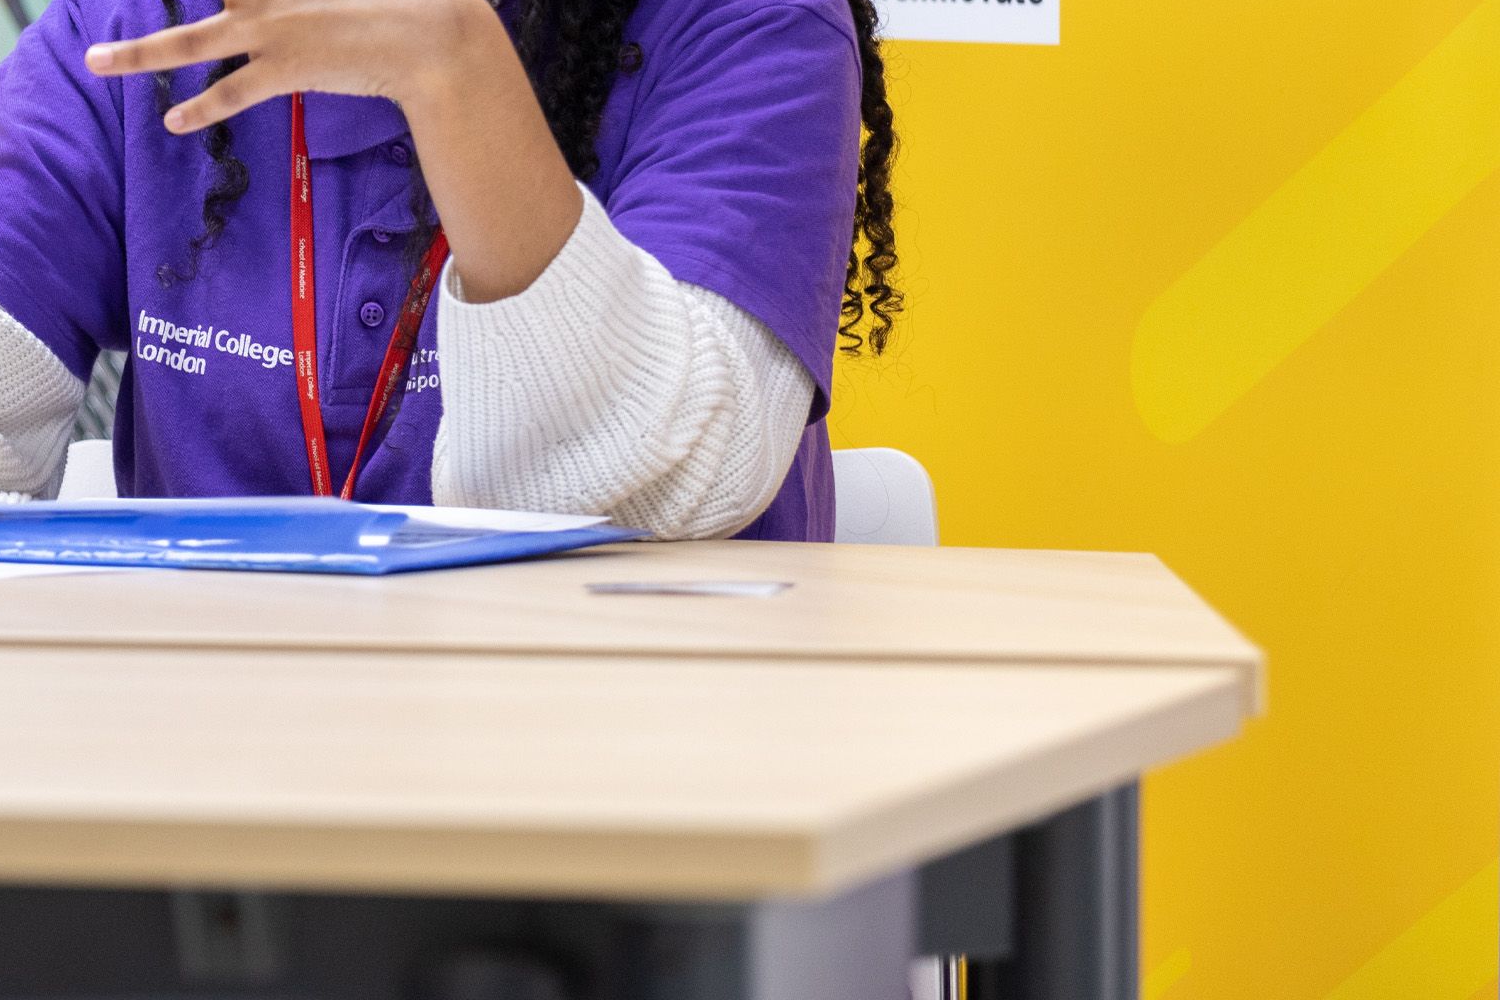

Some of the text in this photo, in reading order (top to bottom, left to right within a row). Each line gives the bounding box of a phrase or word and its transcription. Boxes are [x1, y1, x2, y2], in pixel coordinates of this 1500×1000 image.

[136, 336, 207, 375] London
[137, 309, 295, 369] Imperial College
